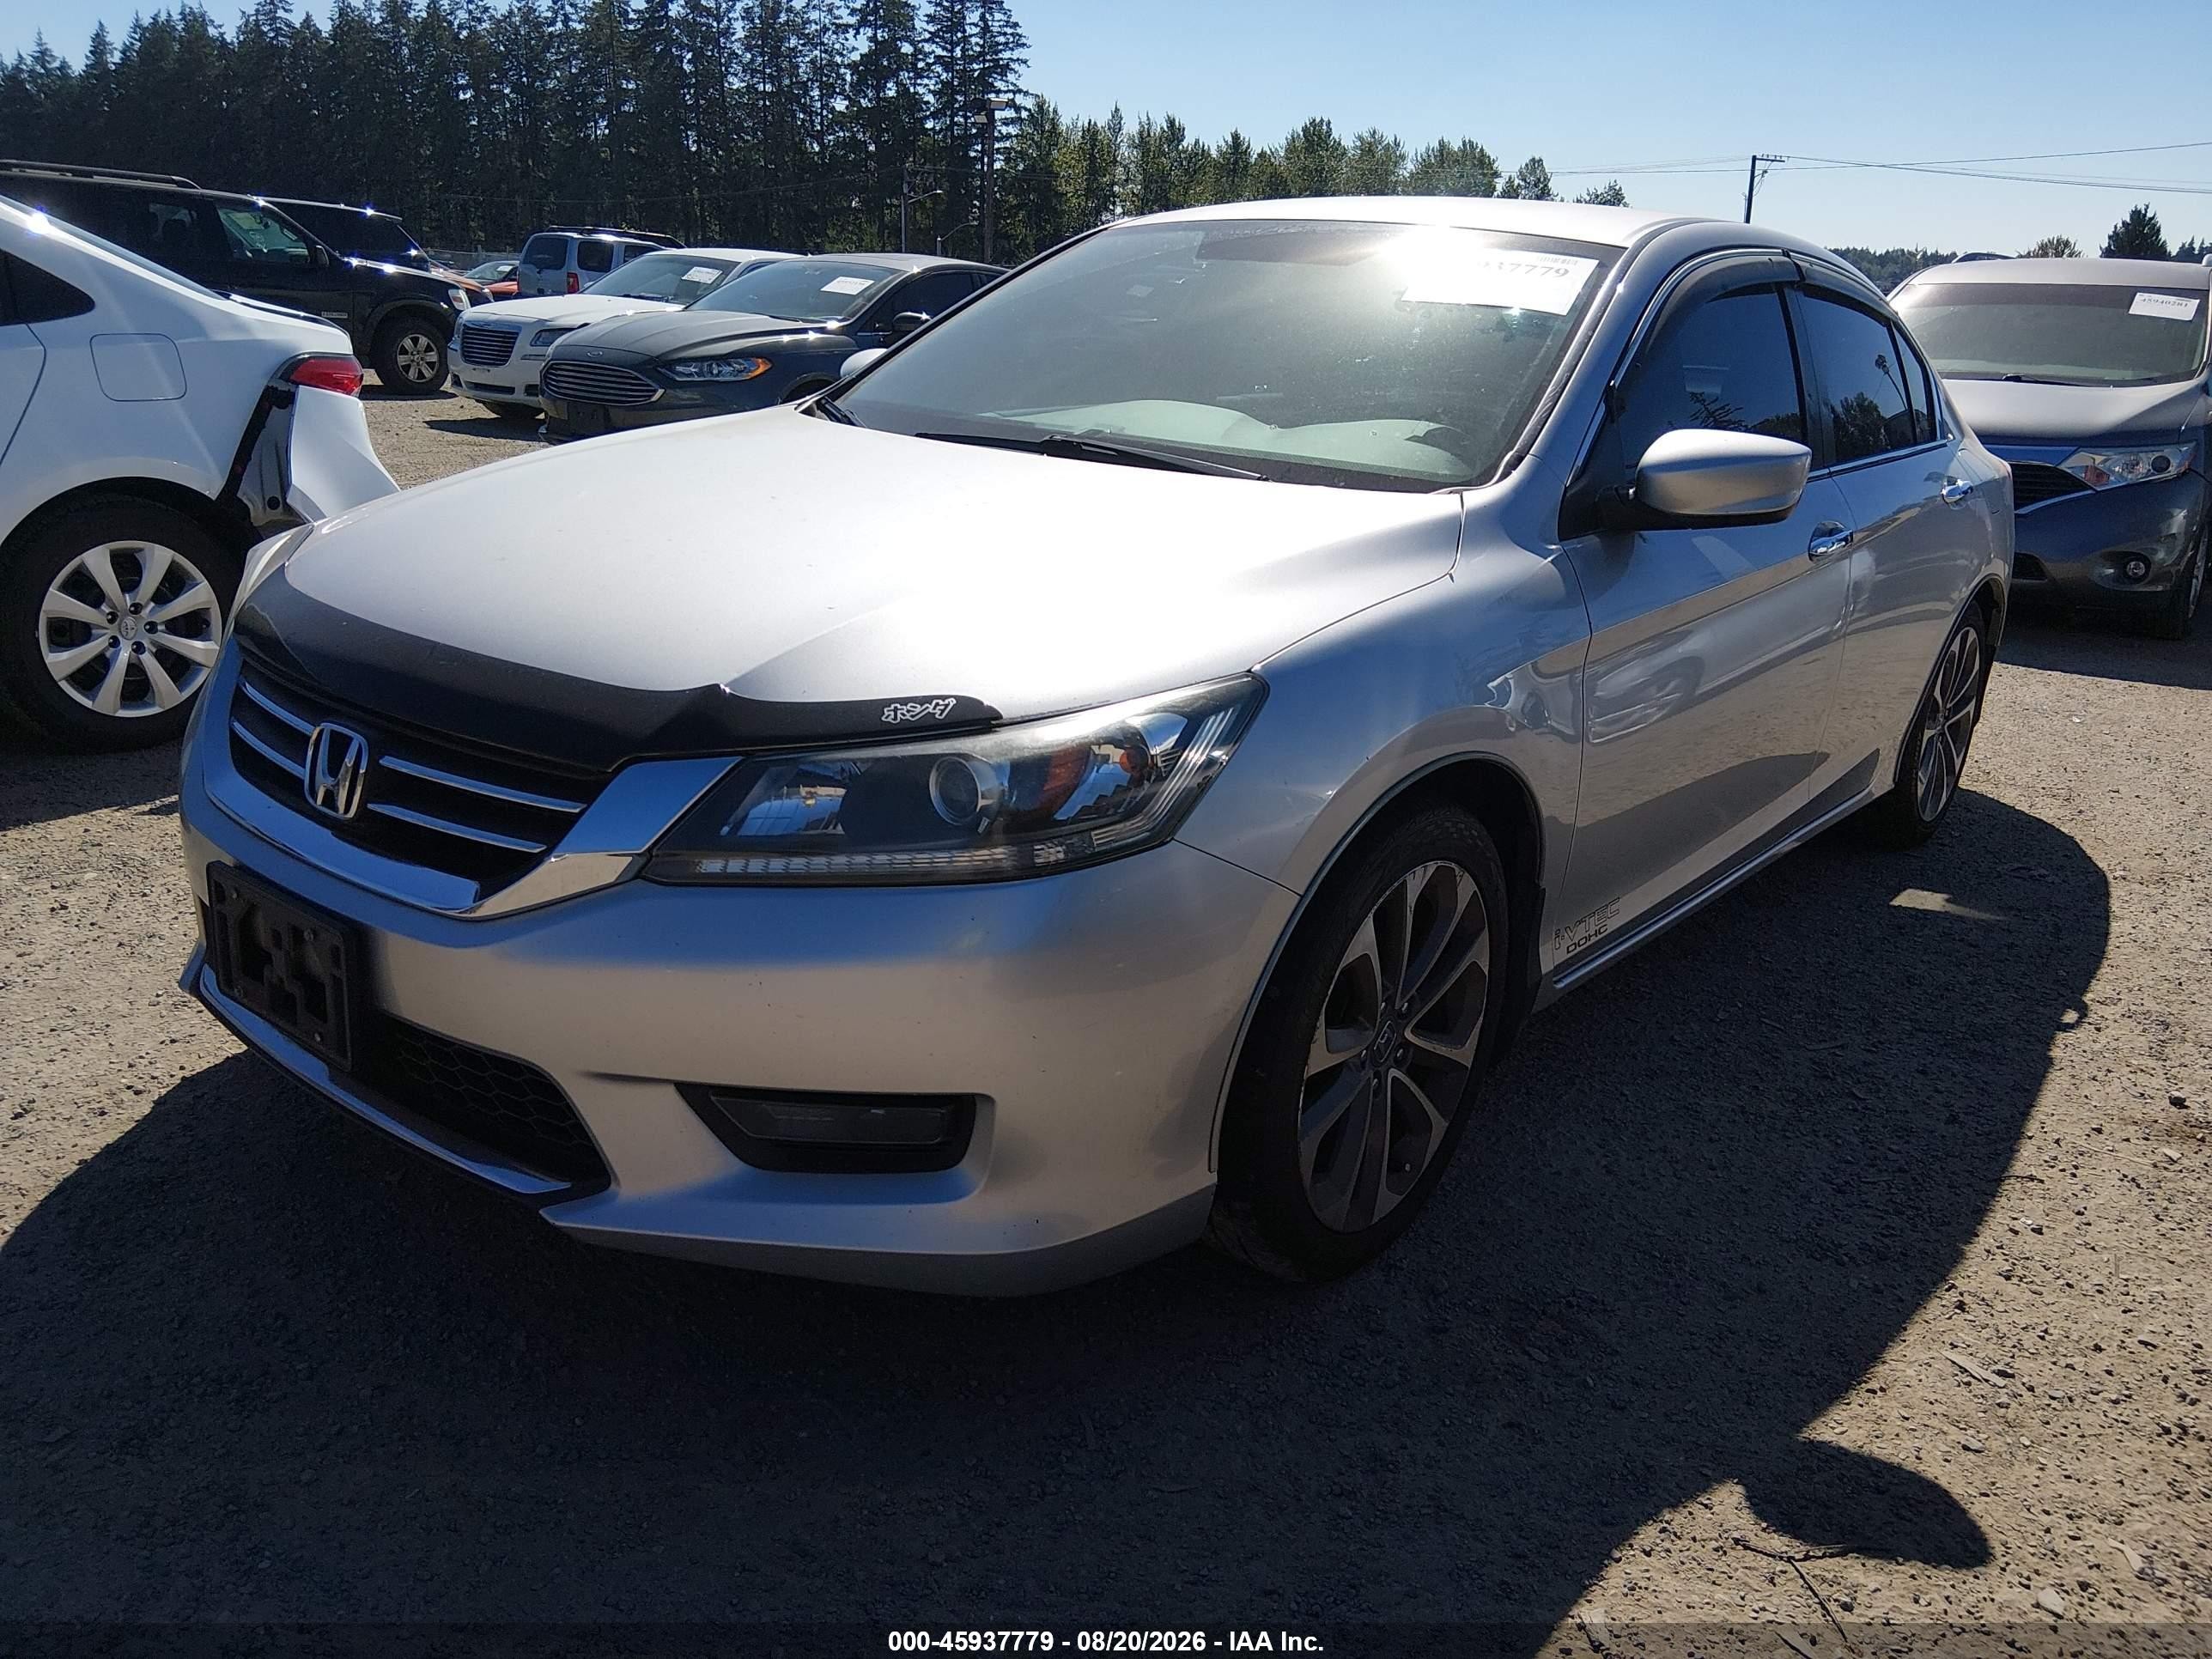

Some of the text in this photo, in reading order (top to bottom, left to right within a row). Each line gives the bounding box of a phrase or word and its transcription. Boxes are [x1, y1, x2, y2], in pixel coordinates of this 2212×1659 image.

[881, 697, 957, 723] ホンダ
[1554, 897, 1620, 951] i-VTEC
[1566, 924, 1607, 954] DOHC
